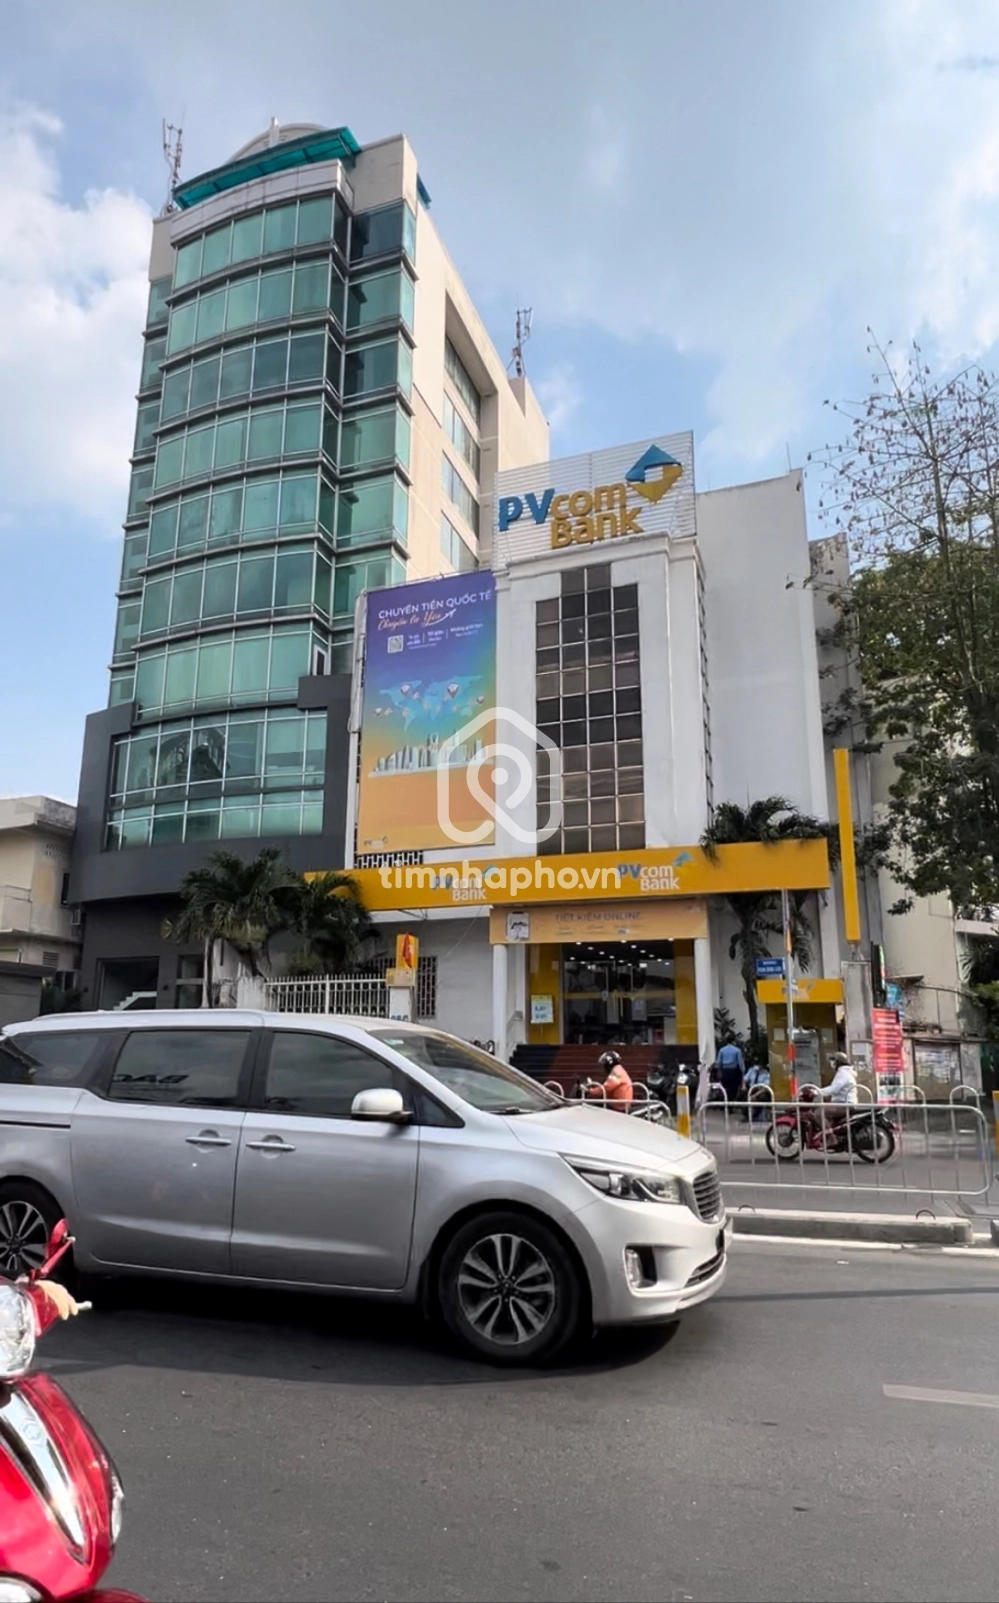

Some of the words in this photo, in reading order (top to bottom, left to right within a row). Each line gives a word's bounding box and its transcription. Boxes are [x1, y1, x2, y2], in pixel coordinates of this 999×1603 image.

[498, 483, 627, 532] PVcom
[551, 507, 644, 549] Bank
[452, 887, 486, 901] Bank
[640, 877, 680, 892] Bank
